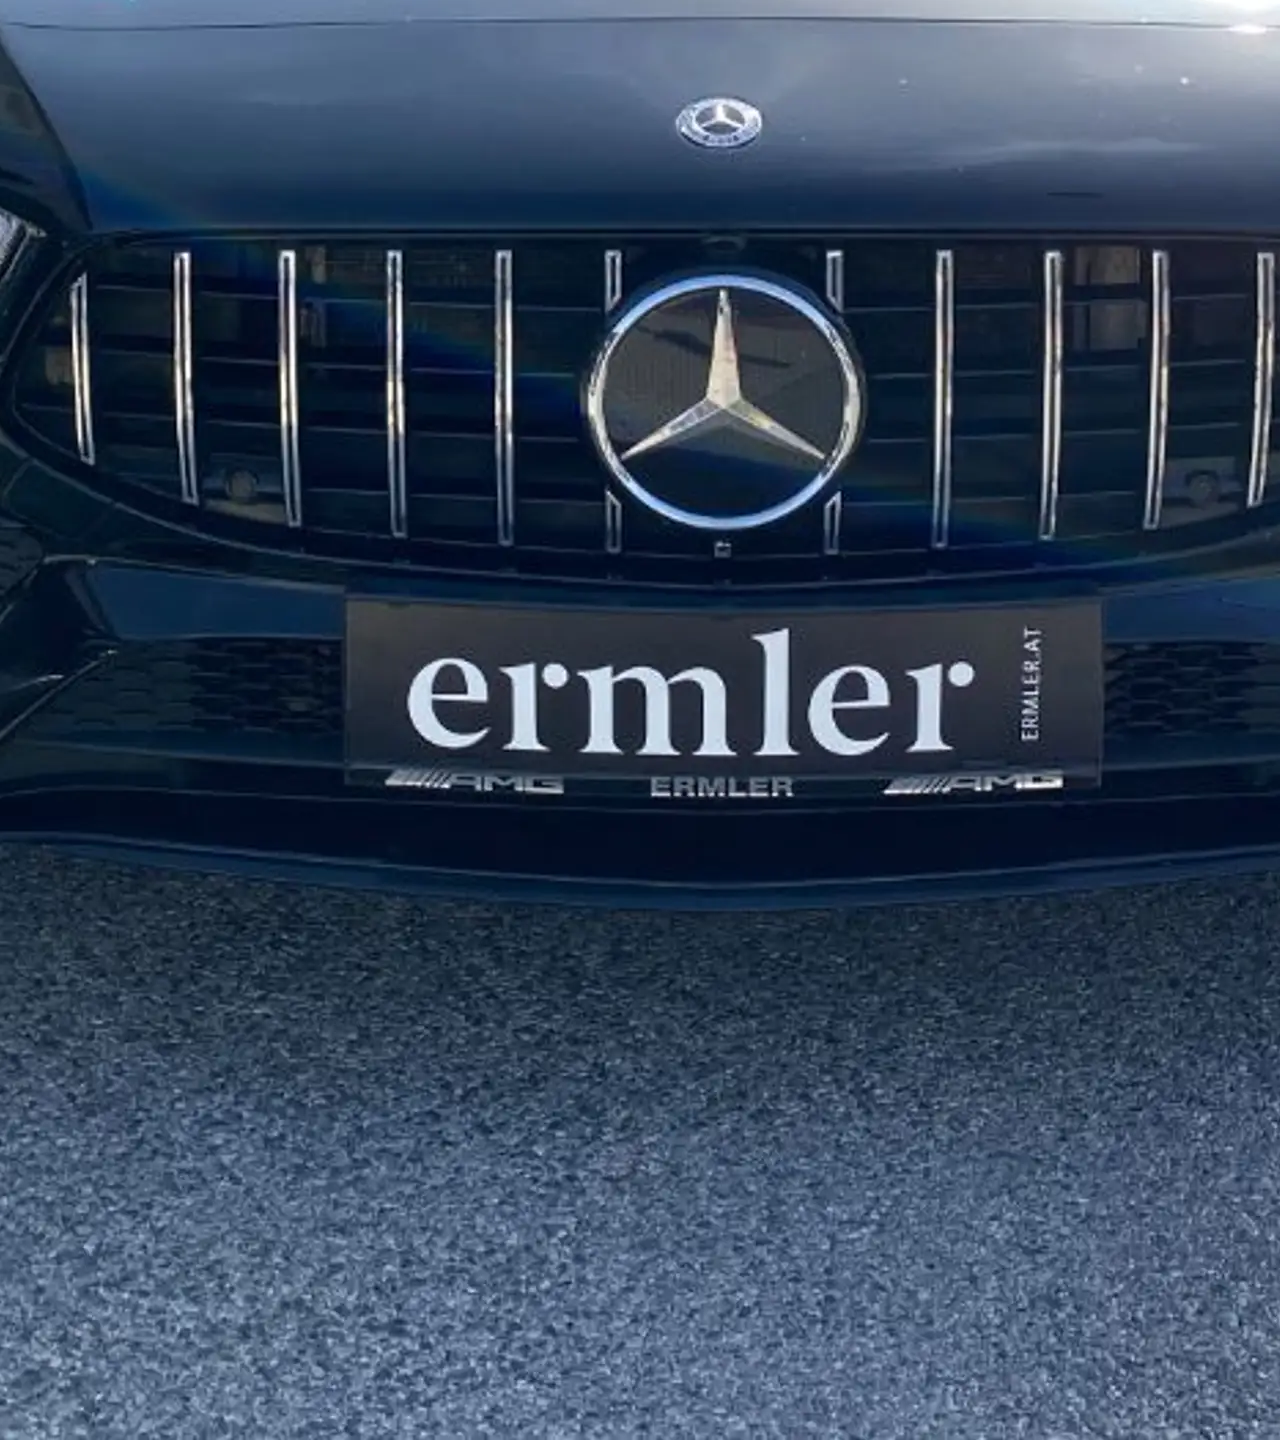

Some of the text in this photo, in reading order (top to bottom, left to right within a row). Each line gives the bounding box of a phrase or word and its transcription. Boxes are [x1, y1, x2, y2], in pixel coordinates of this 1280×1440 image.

[406, 627, 975, 758] ermler
[1019, 625, 1043, 741] ERMLER.AT
[649, 775, 795, 798] ERMLER
